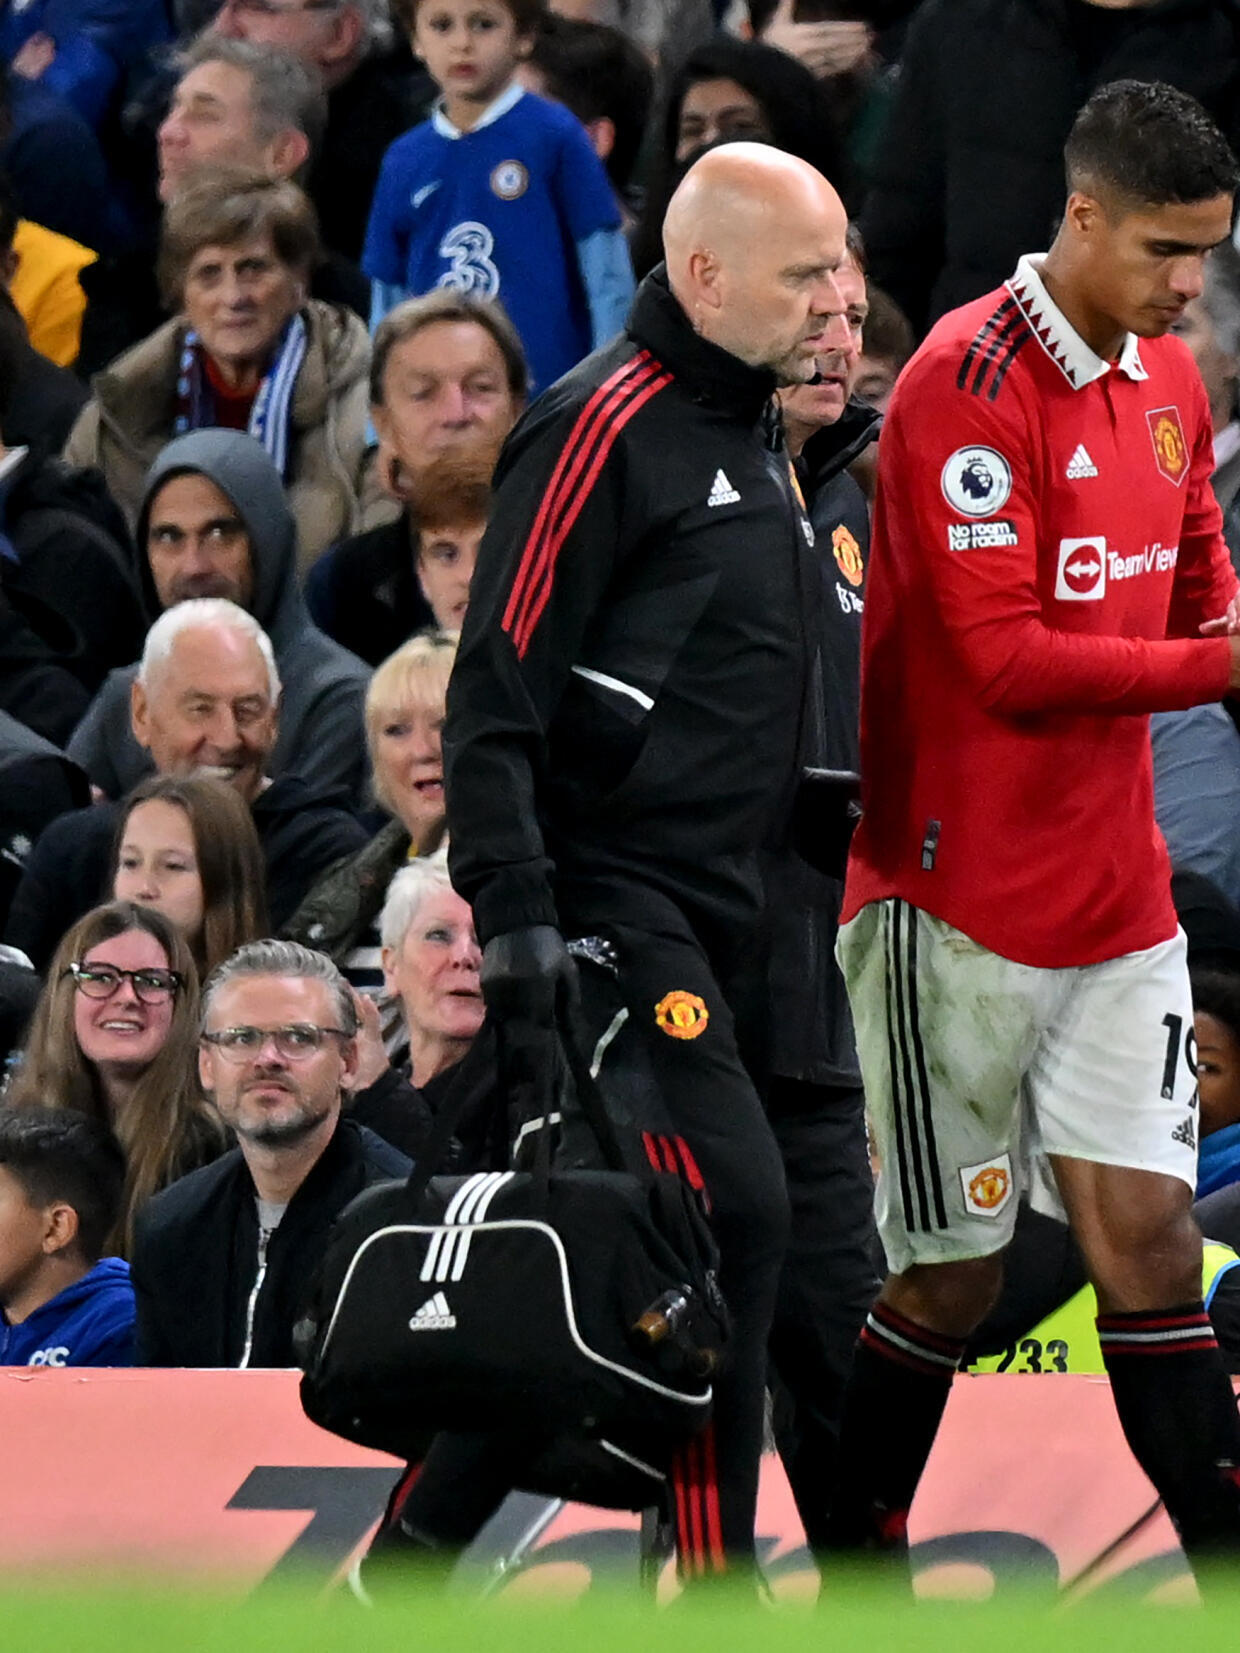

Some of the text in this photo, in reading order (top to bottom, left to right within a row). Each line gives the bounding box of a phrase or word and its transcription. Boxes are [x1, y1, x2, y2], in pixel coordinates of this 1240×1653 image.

[1066, 466, 1098, 479] adidas
[948, 521, 1010, 539] No room
[949, 537, 971, 551] for
[409, 1315, 456, 1331] adidas
